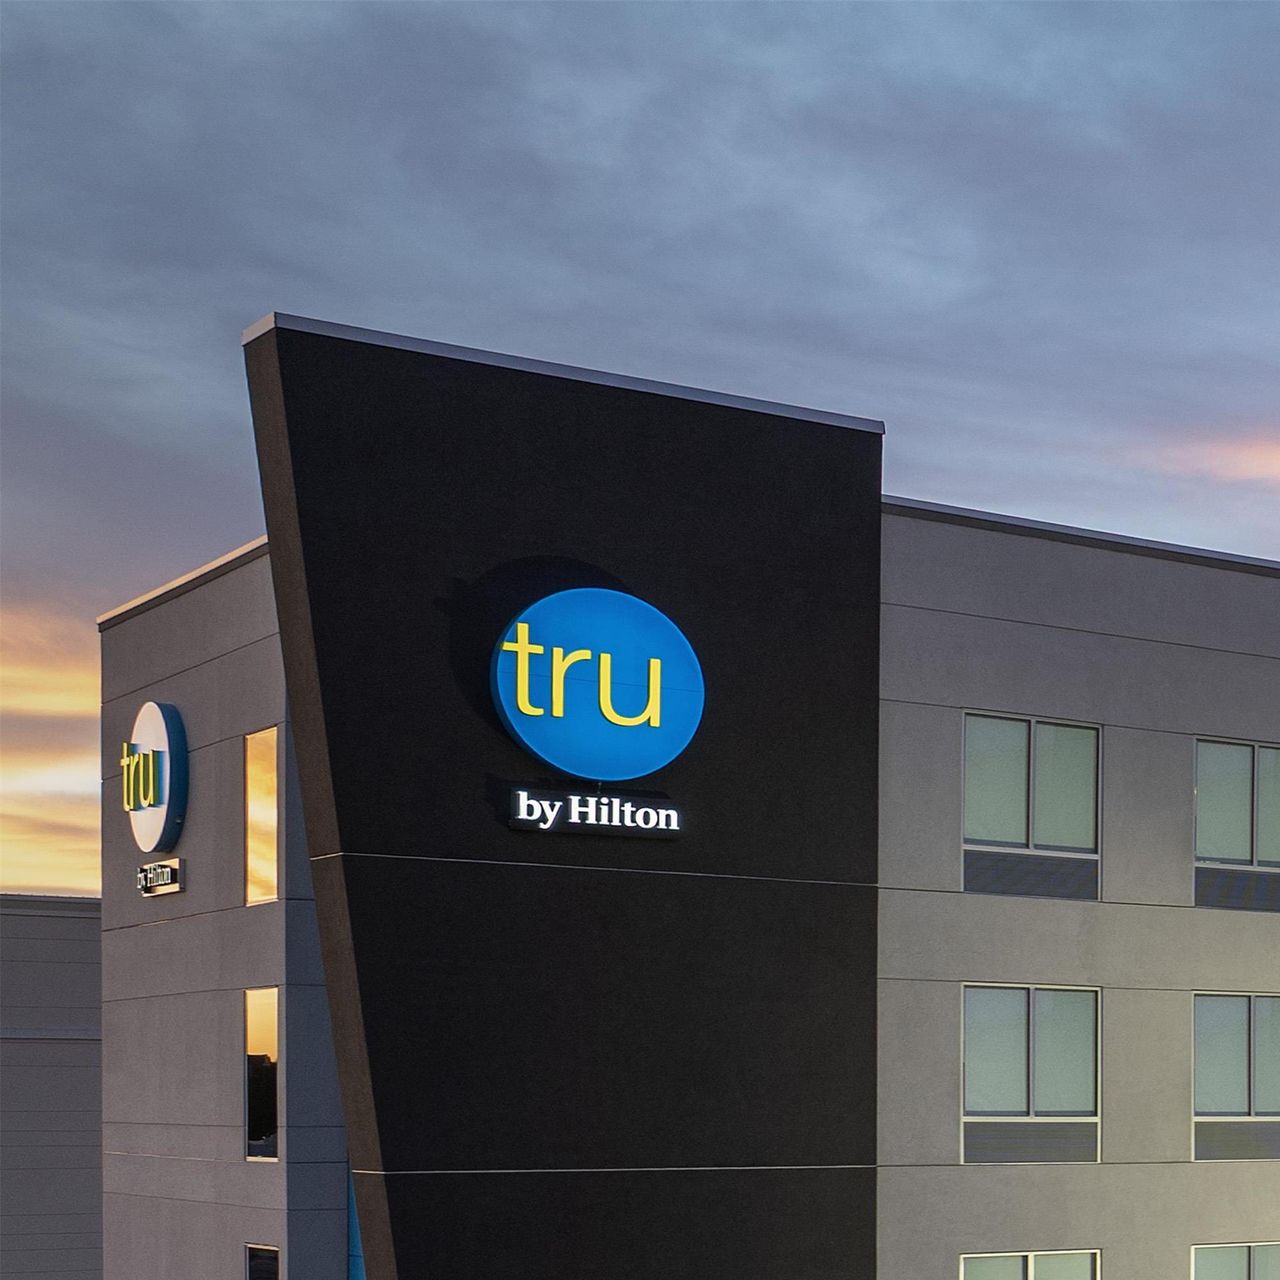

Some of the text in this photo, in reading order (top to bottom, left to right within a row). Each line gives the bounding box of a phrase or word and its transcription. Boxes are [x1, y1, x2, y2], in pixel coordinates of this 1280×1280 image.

[501, 621, 662, 728] tru
[120, 742, 154, 812] tru
[515, 790, 680, 831] by Hilton
